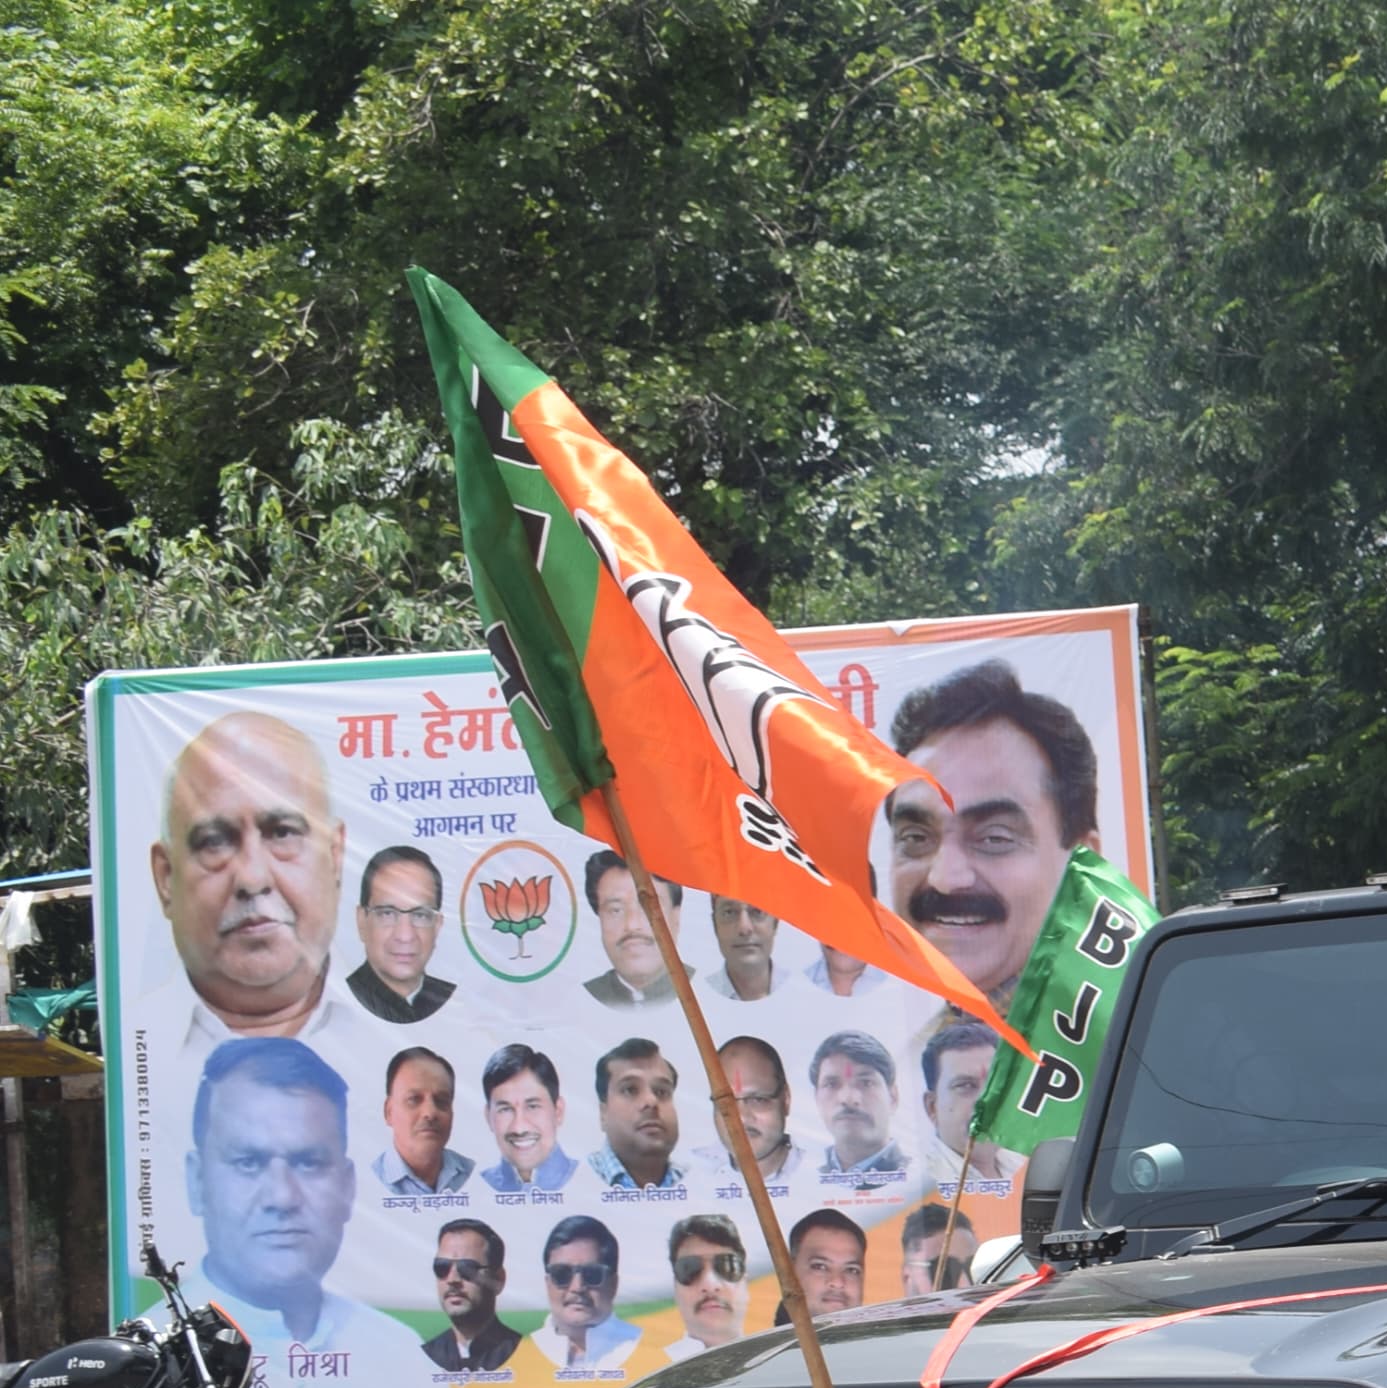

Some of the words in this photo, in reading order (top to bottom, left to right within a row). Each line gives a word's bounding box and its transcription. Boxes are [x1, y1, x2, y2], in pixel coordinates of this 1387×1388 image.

[337, 714, 410, 759] मा.
[370, 776, 388, 803] के
[395, 780, 441, 803] प्रथम
[449, 772, 538, 800] संस्कारधा
[413, 814, 484, 838] आगमन
[492, 812, 517, 834] पर
[1015, 895, 1140, 1120] BJP
[600, 1184, 641, 1203] अमित
[646, 1183, 688, 1202] तिवारी
[288, 1343, 352, 1379] मिश्रा
